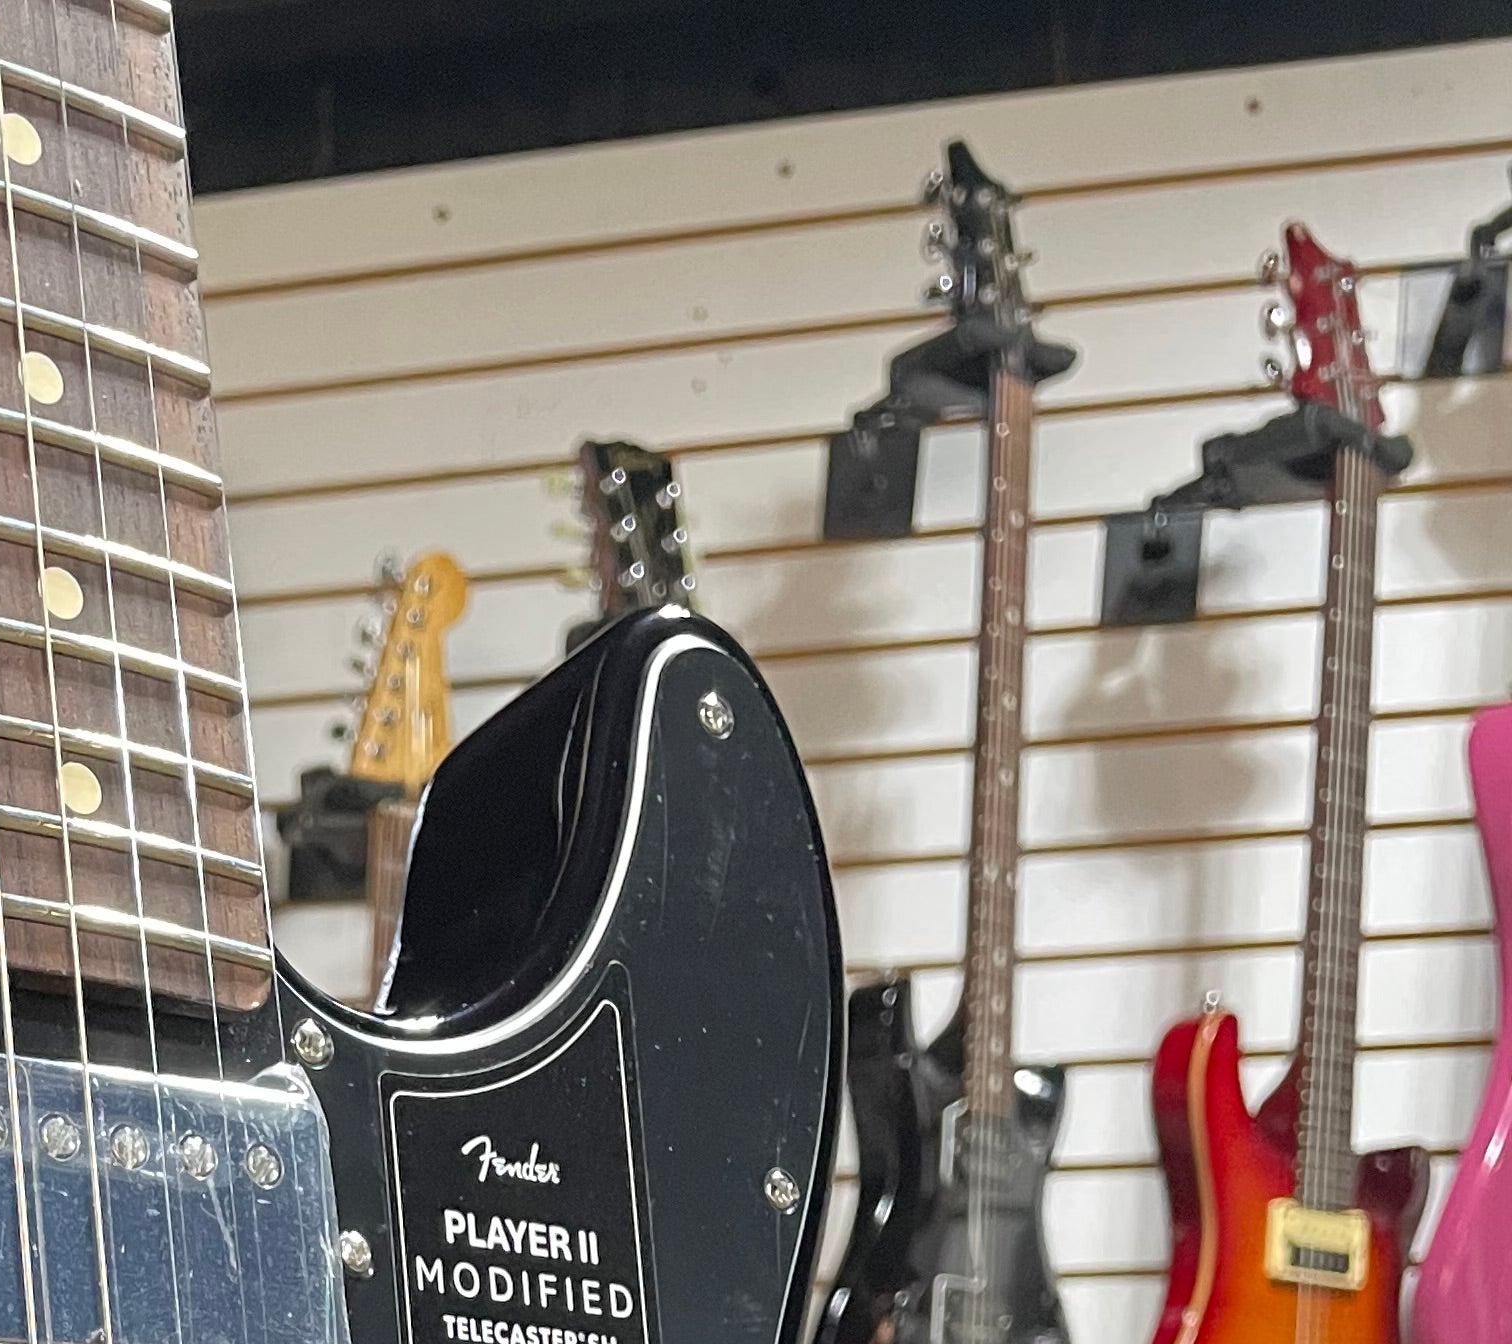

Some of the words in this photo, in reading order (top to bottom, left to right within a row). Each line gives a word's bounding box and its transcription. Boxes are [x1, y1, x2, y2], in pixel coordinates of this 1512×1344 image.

[461, 1135, 560, 1184] Fender
[443, 1209, 573, 1262] PLAYER
[577, 1229, 600, 1266] II
[415, 1255, 634, 1319] MODIFIED
